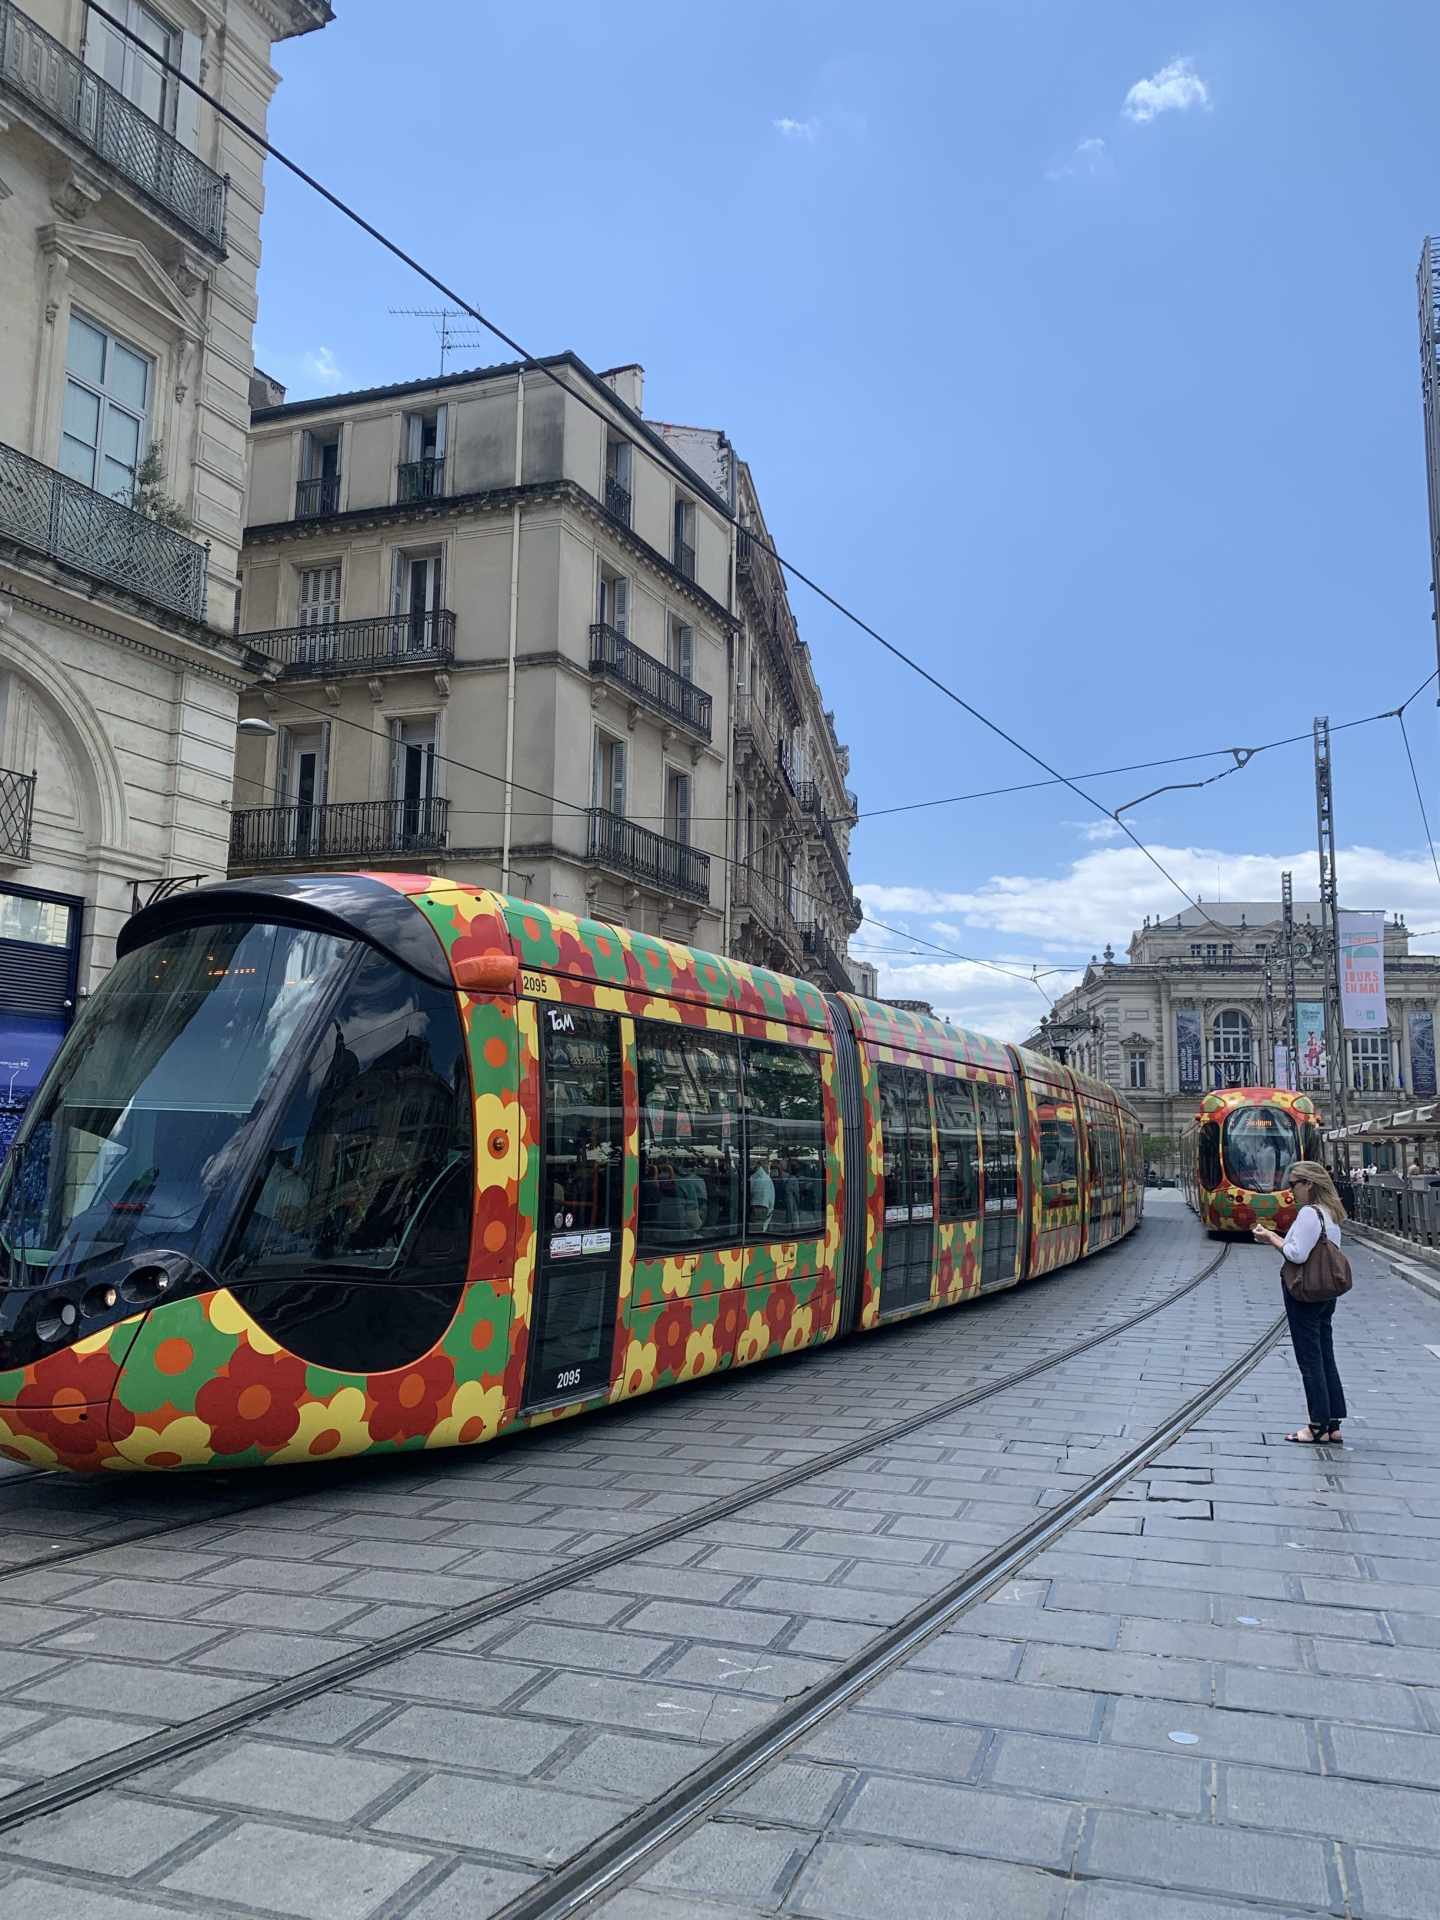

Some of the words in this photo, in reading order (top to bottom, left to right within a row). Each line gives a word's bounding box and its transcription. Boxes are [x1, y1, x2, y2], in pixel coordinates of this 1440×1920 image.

[1344, 971, 1379, 982] JOURS
[523, 975, 547, 993] 2095
[1359, 982, 1380, 993] MAI
[556, 1368, 581, 1389] 2095
